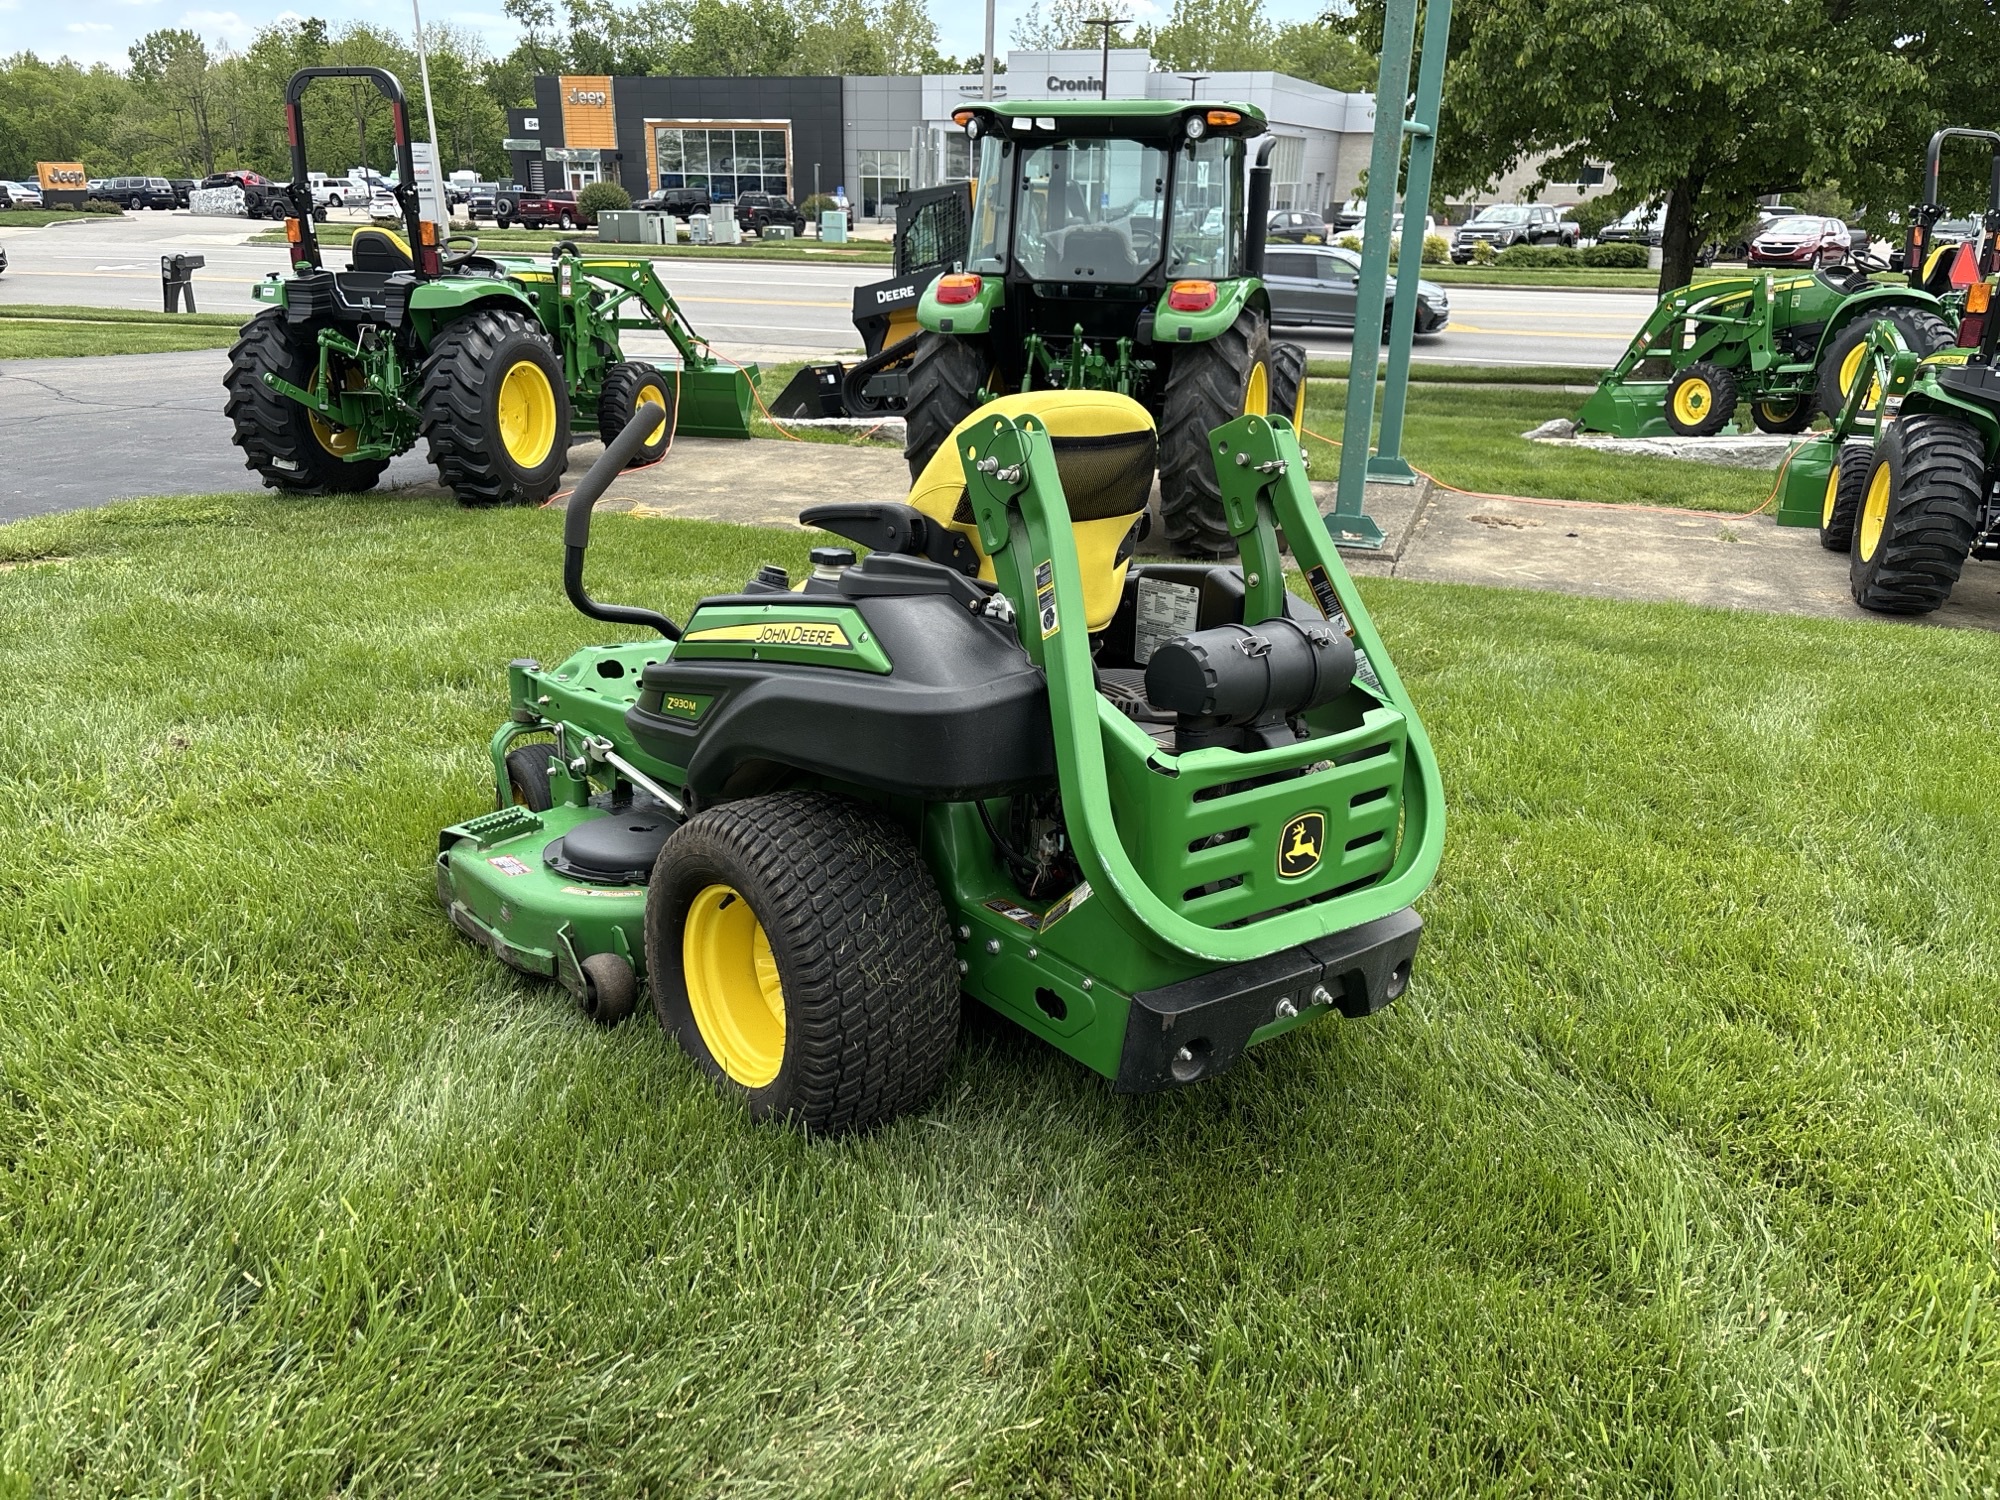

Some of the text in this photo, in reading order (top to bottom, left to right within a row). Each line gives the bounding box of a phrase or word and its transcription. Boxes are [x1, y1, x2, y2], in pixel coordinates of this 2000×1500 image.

[1047, 76, 1103, 91] Cronin
[568, 87, 606, 108] Jeep
[48, 167, 84, 186] Jeep
[876, 285, 916, 304] DEERE
[756, 626, 835, 644] JOHN DEERE
[667, 697, 696, 710] Z930M
